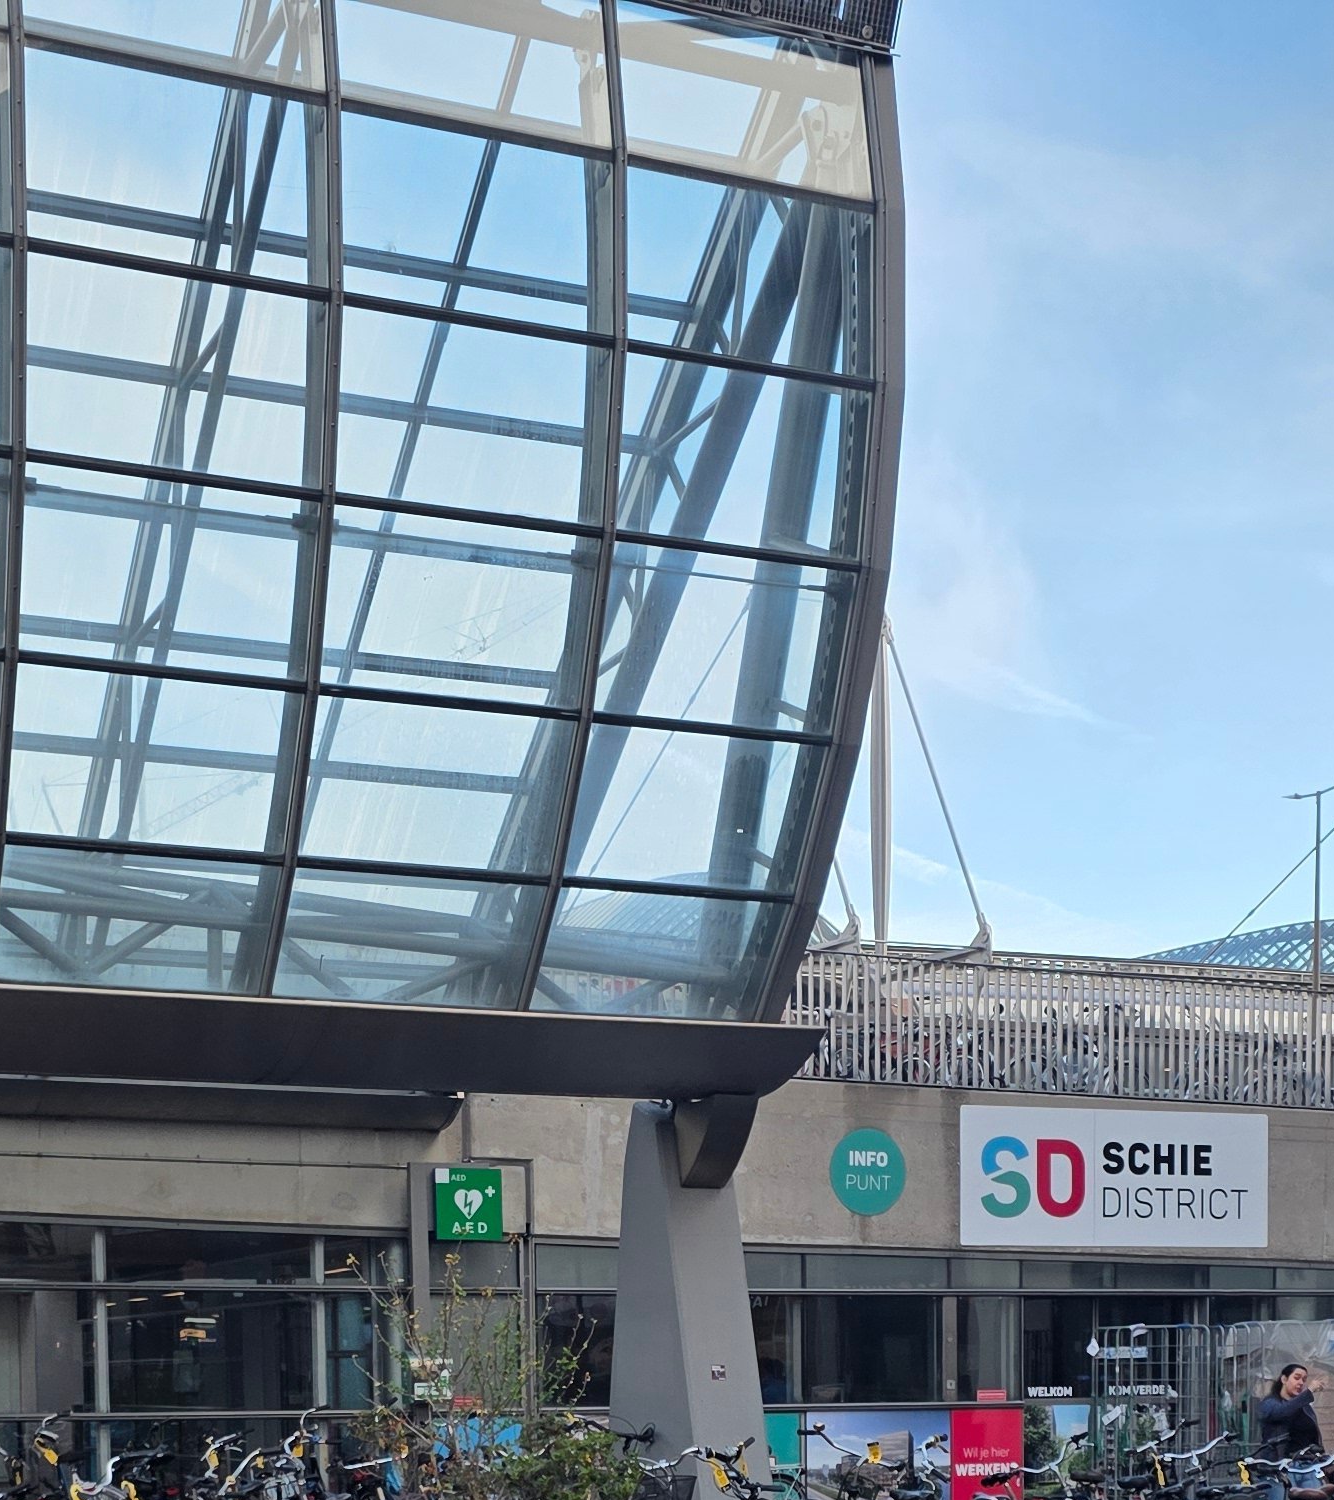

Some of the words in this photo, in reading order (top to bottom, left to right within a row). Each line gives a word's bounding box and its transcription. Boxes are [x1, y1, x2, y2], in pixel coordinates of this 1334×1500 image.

[848, 1150, 888, 1168] INFO
[1102, 1141, 1213, 1177] SCHIE
[451, 1174, 467, 1182] AED
[845, 1174, 892, 1192] PUNT
[980, 1135, 1086, 1219] SD
[1102, 1187, 1249, 1221] DISTRICT
[1027, 1386, 1073, 1397] WELKOM
[963, 1447, 978, 1458] Wil
[979, 1447, 989, 1460] je
[991, 1446, 1010, 1457] hier
